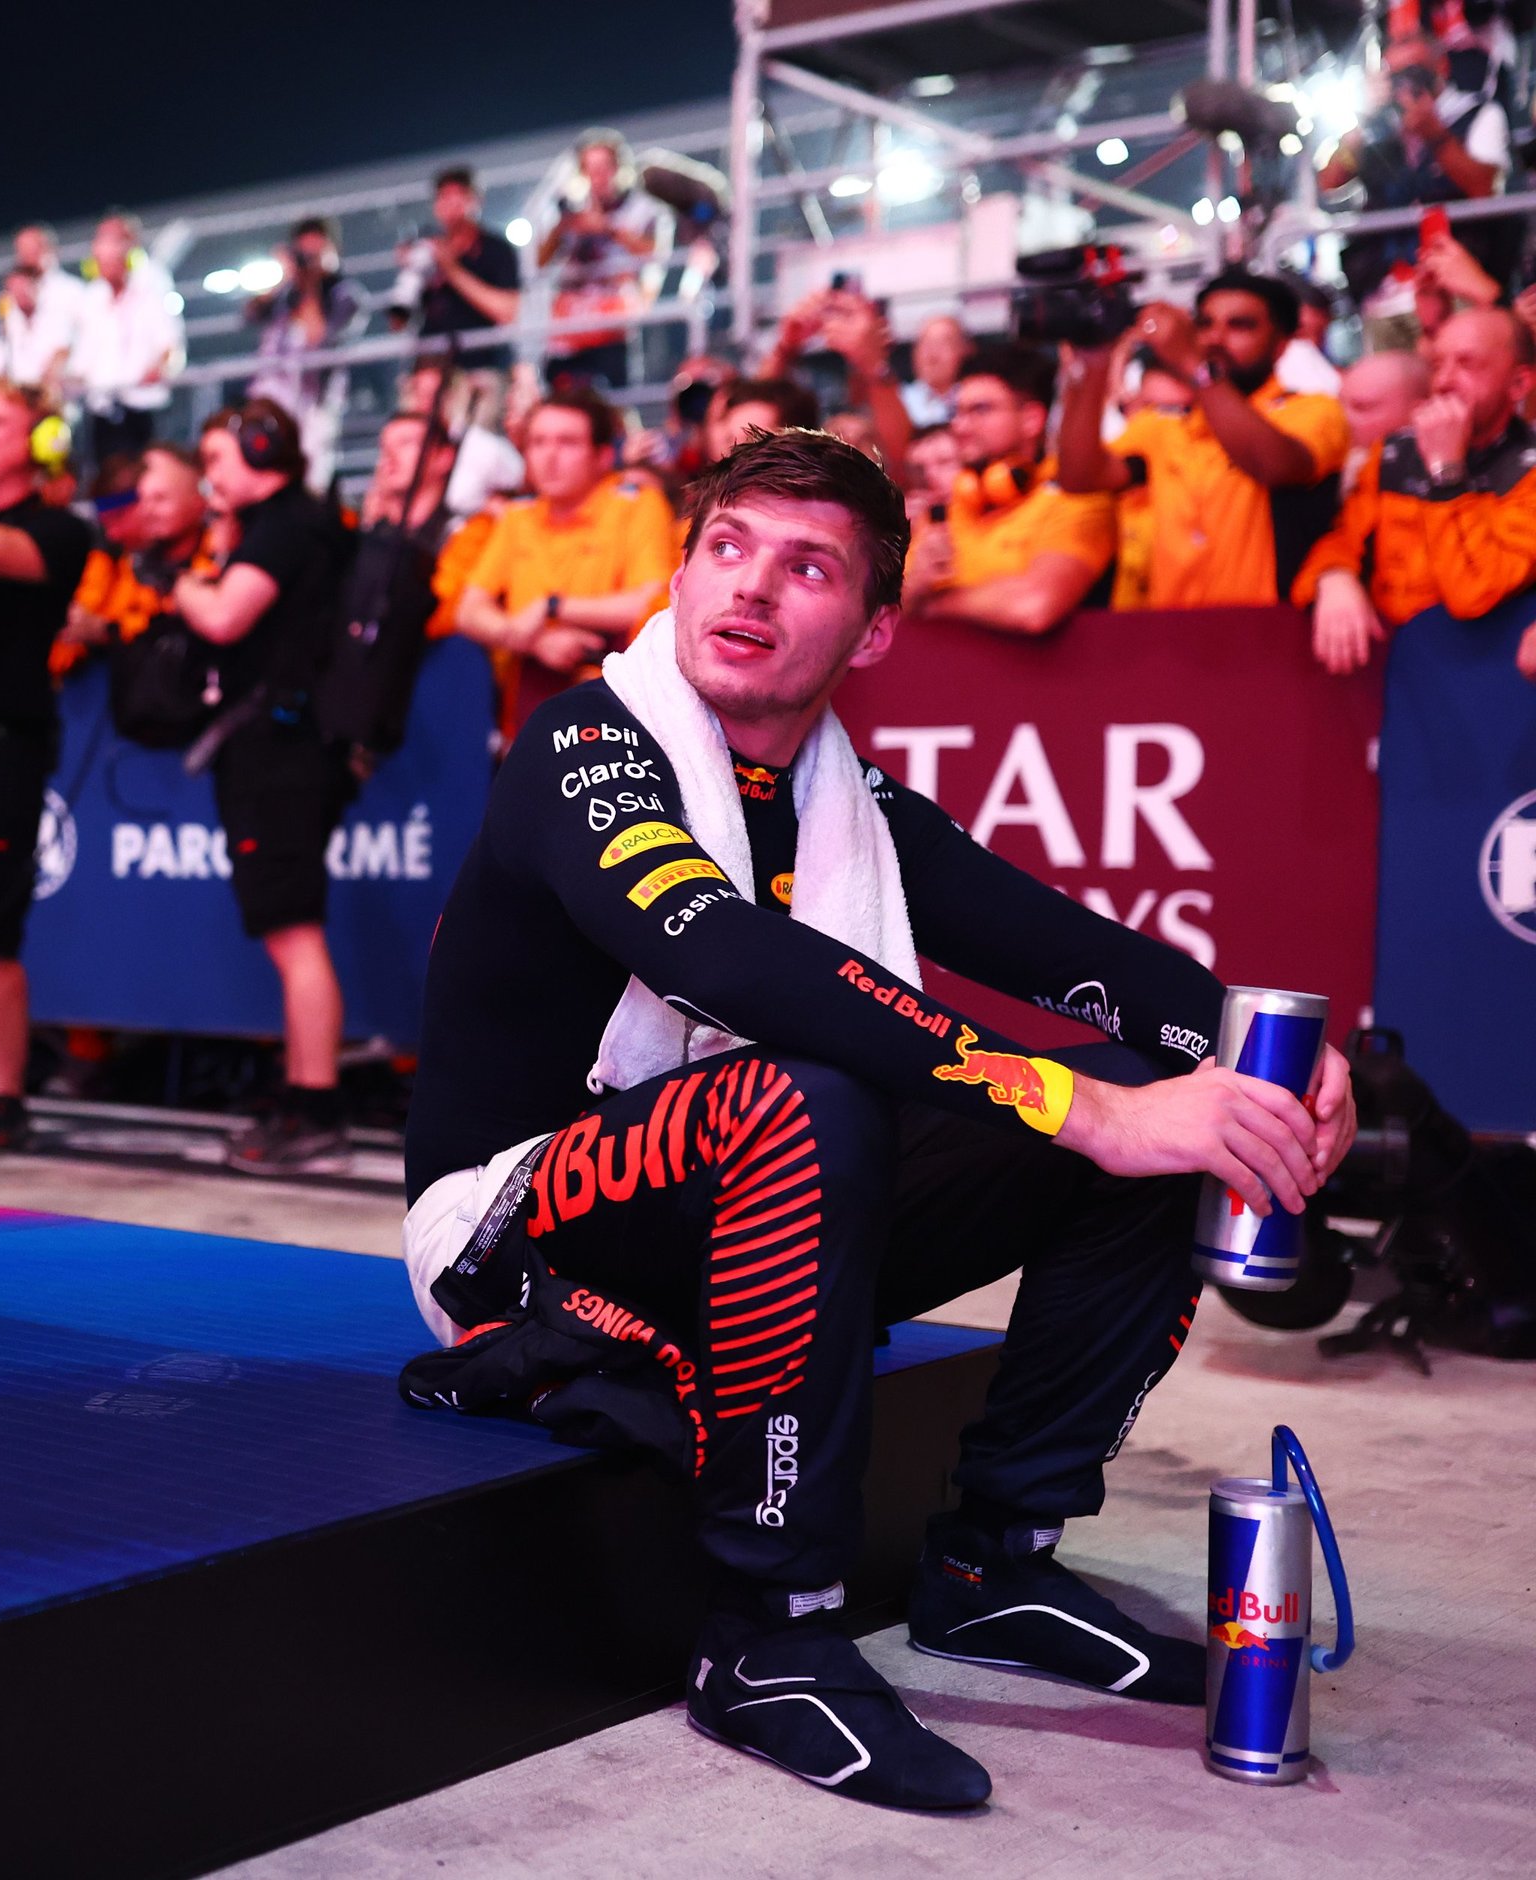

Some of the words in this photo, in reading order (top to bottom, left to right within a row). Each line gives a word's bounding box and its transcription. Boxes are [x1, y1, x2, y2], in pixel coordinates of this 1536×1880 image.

[553, 723, 639, 753] Mobil
[561, 758, 648, 798] Claro
[750, 784, 777, 801] Bull
[871, 722, 1215, 872] TAR
[616, 791, 664, 813] Sui
[621, 828, 684, 850] RAUCH
[638, 862, 719, 900] PIRELLI
[664, 891, 720, 937] Cash
[837, 959, 898, 1006] Red
[892, 992, 952, 1038] Bull
[1032, 995, 1093, 1023] Hard
[1092, 1002, 1123, 1041] Rock
[1160, 1023, 1209, 1058] sparco
[561, 1288, 656, 1345] WINGS
[755, 1414, 799, 1528] sparco
[943, 1555, 983, 1575] ORACLE
[1239, 1591, 1299, 1624] Bull
